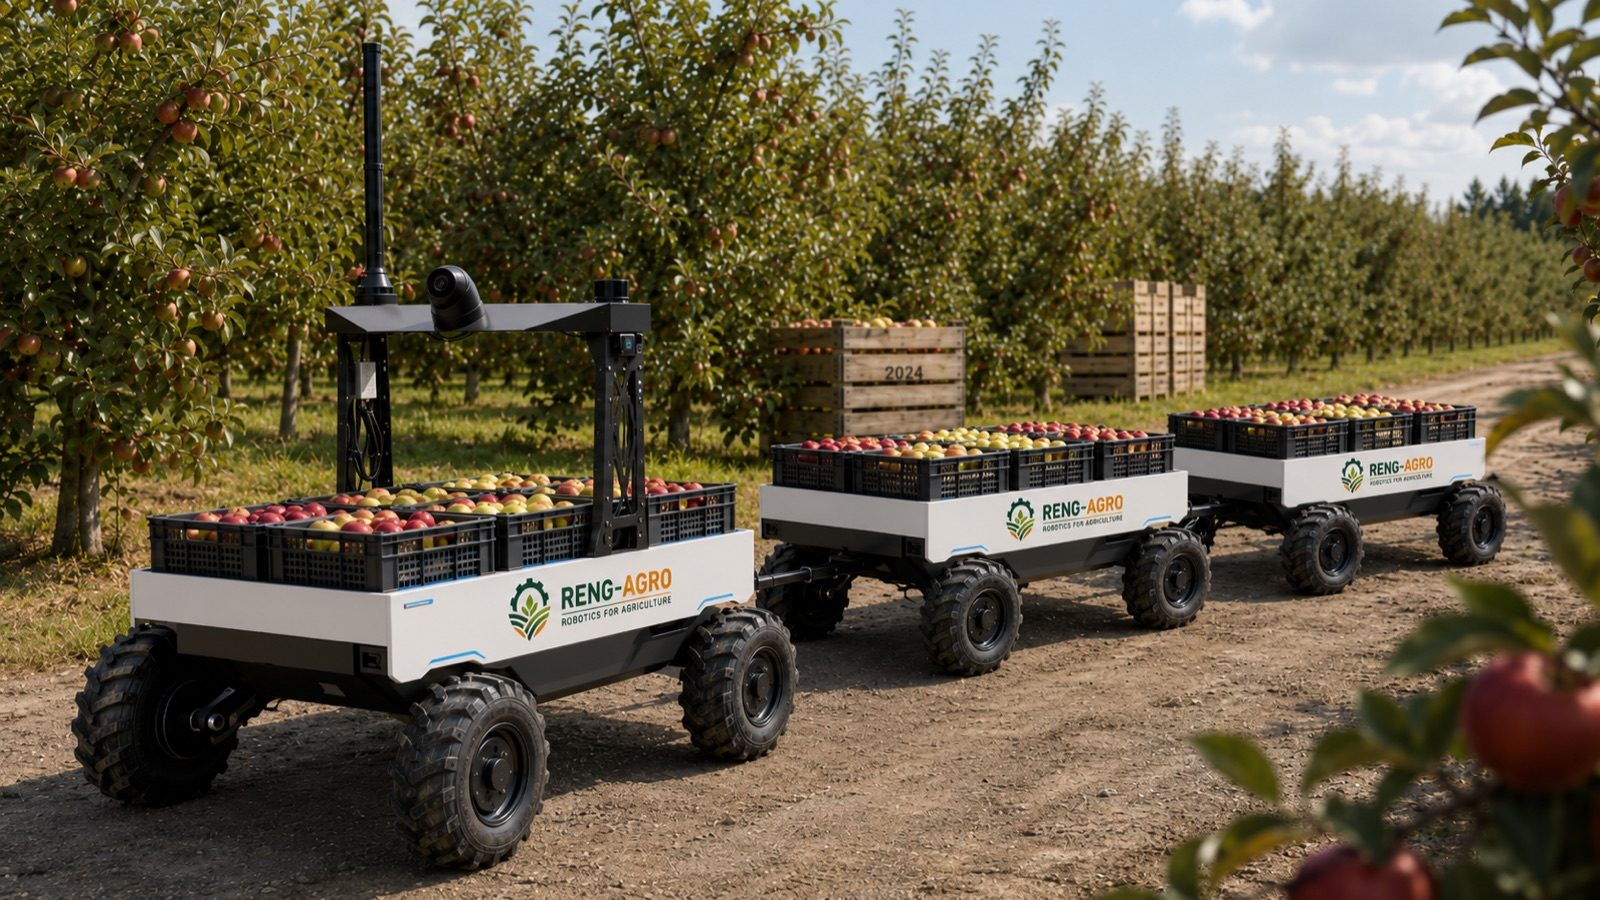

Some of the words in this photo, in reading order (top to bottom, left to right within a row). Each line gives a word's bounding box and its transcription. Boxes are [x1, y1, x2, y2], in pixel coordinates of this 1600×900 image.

[885, 365, 923, 380] 2024
[1369, 456, 1433, 476] RENG-AGRO
[1042, 495, 1123, 520] RENG-AGRO
[561, 568, 672, 610] RENG-AGRO
[561, 610, 601, 627] ROBOTICS
[603, 607, 619, 618] FOR
[621, 595, 672, 614] AGRICULTURE
